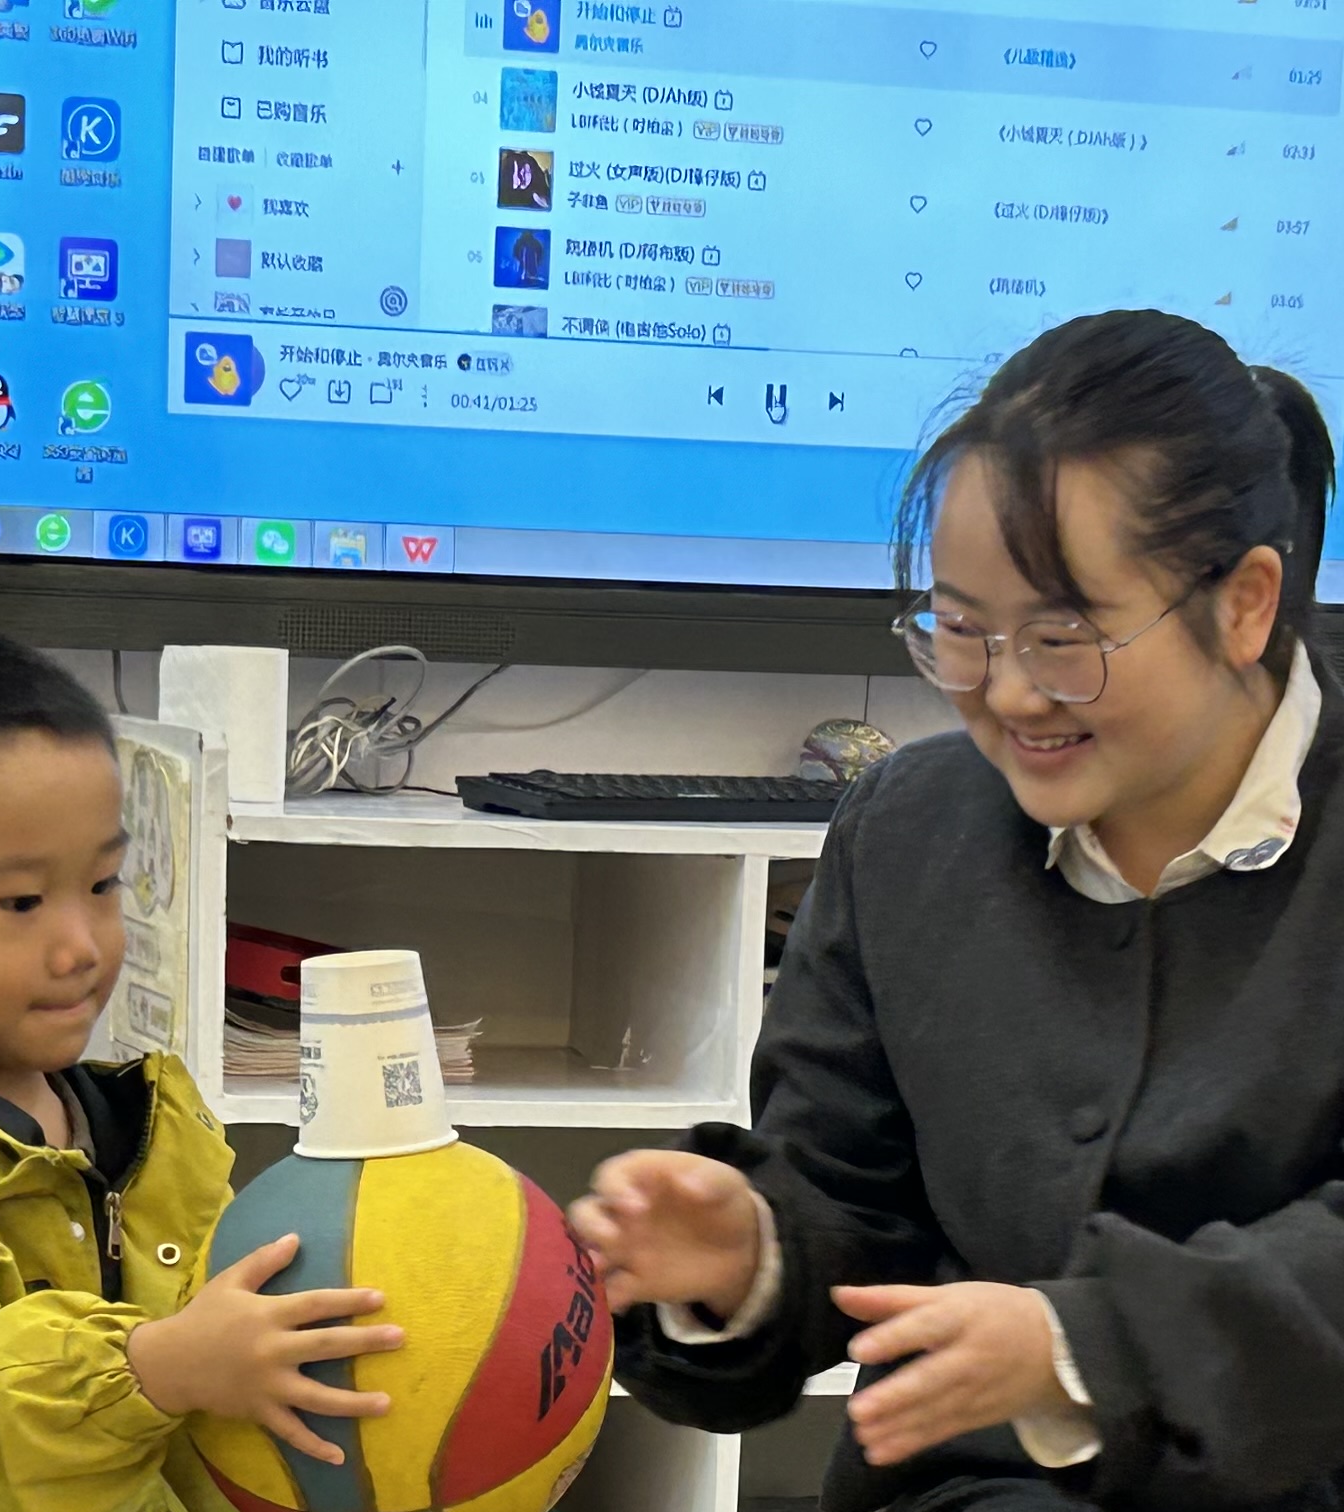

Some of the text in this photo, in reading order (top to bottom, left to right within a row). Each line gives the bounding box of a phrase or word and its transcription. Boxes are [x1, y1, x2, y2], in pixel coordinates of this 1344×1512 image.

[258, 45, 329, 69] 我的听书
[257, 99, 327, 123] 已购音乐
